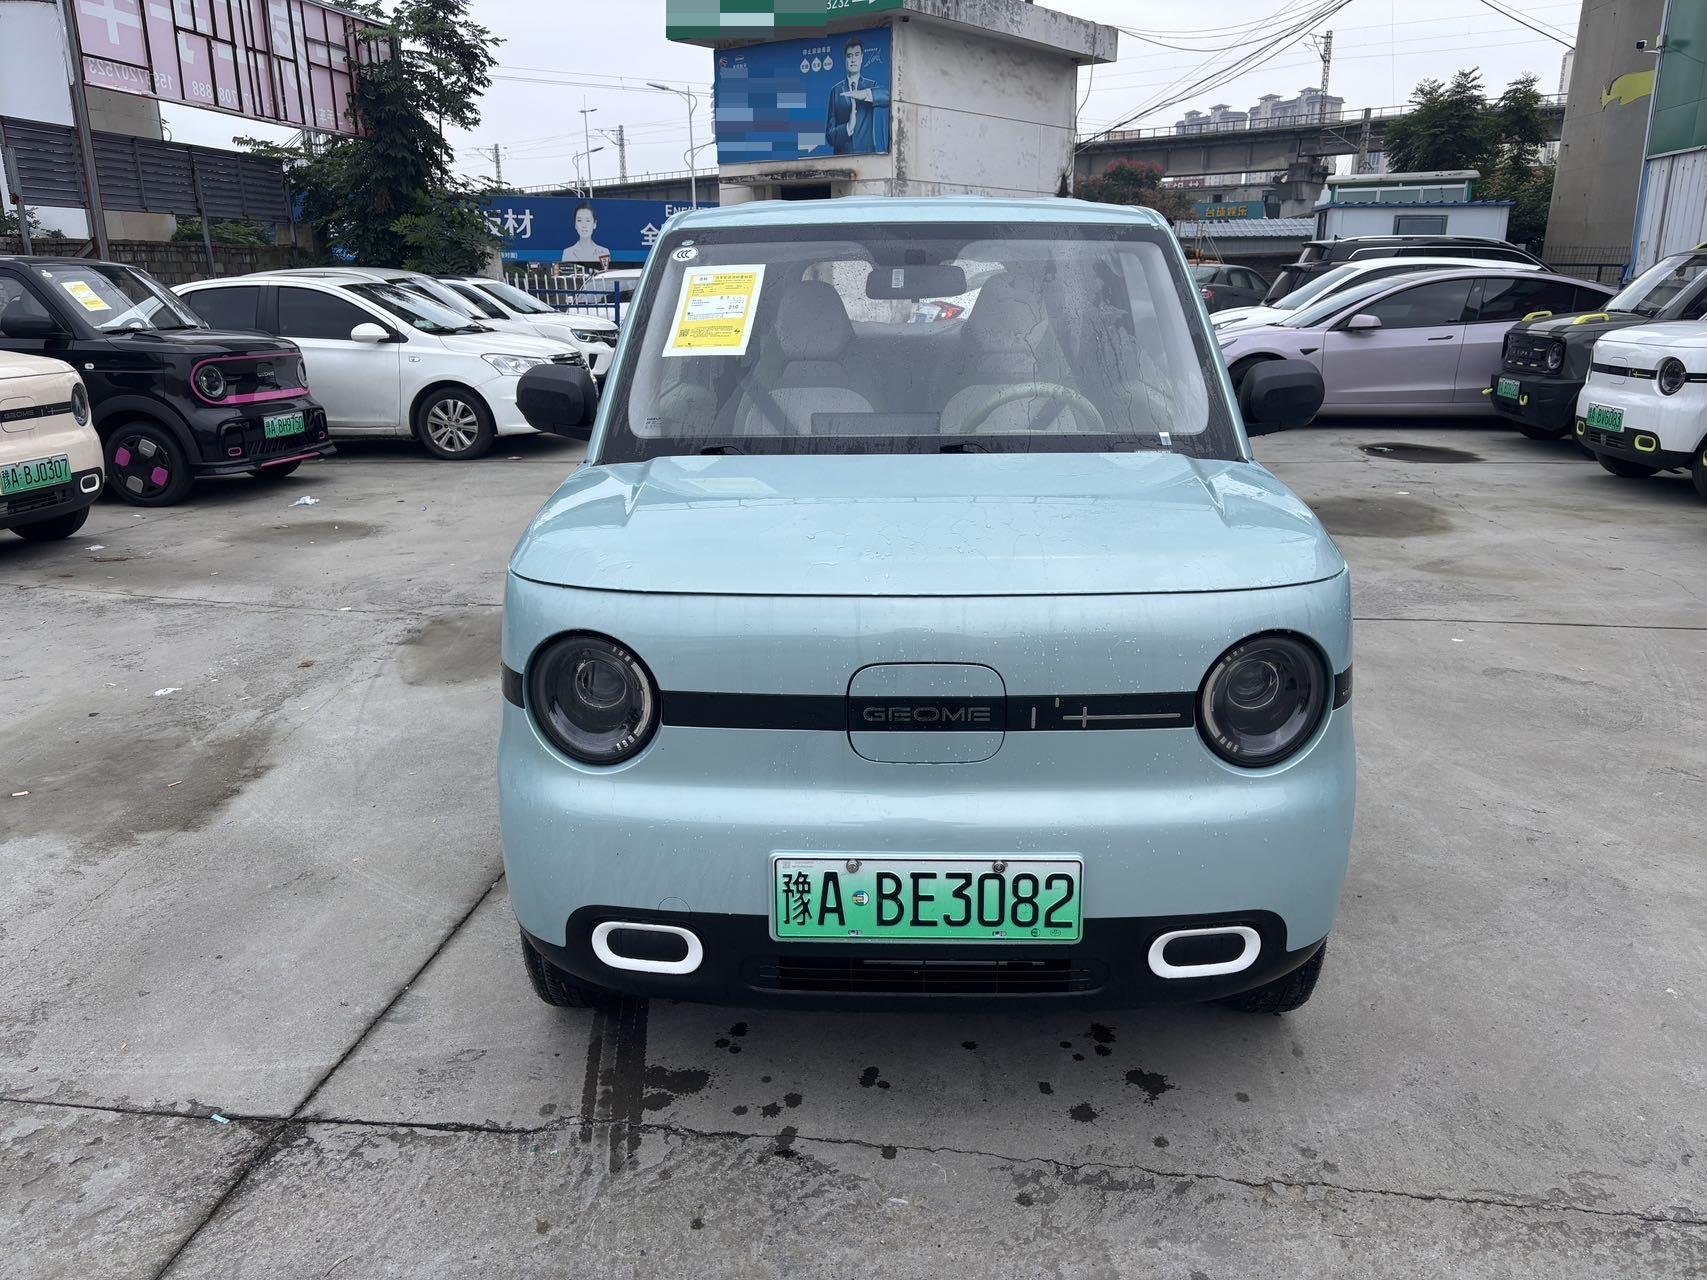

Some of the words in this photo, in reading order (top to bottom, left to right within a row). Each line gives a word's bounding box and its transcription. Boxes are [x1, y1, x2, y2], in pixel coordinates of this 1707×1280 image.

[24, 458, 67, 485] BJ0307
[862, 706, 991, 722] GEOME
[782, 871, 846, 926] 豫A
[875, 871, 1075, 928] BE3082
